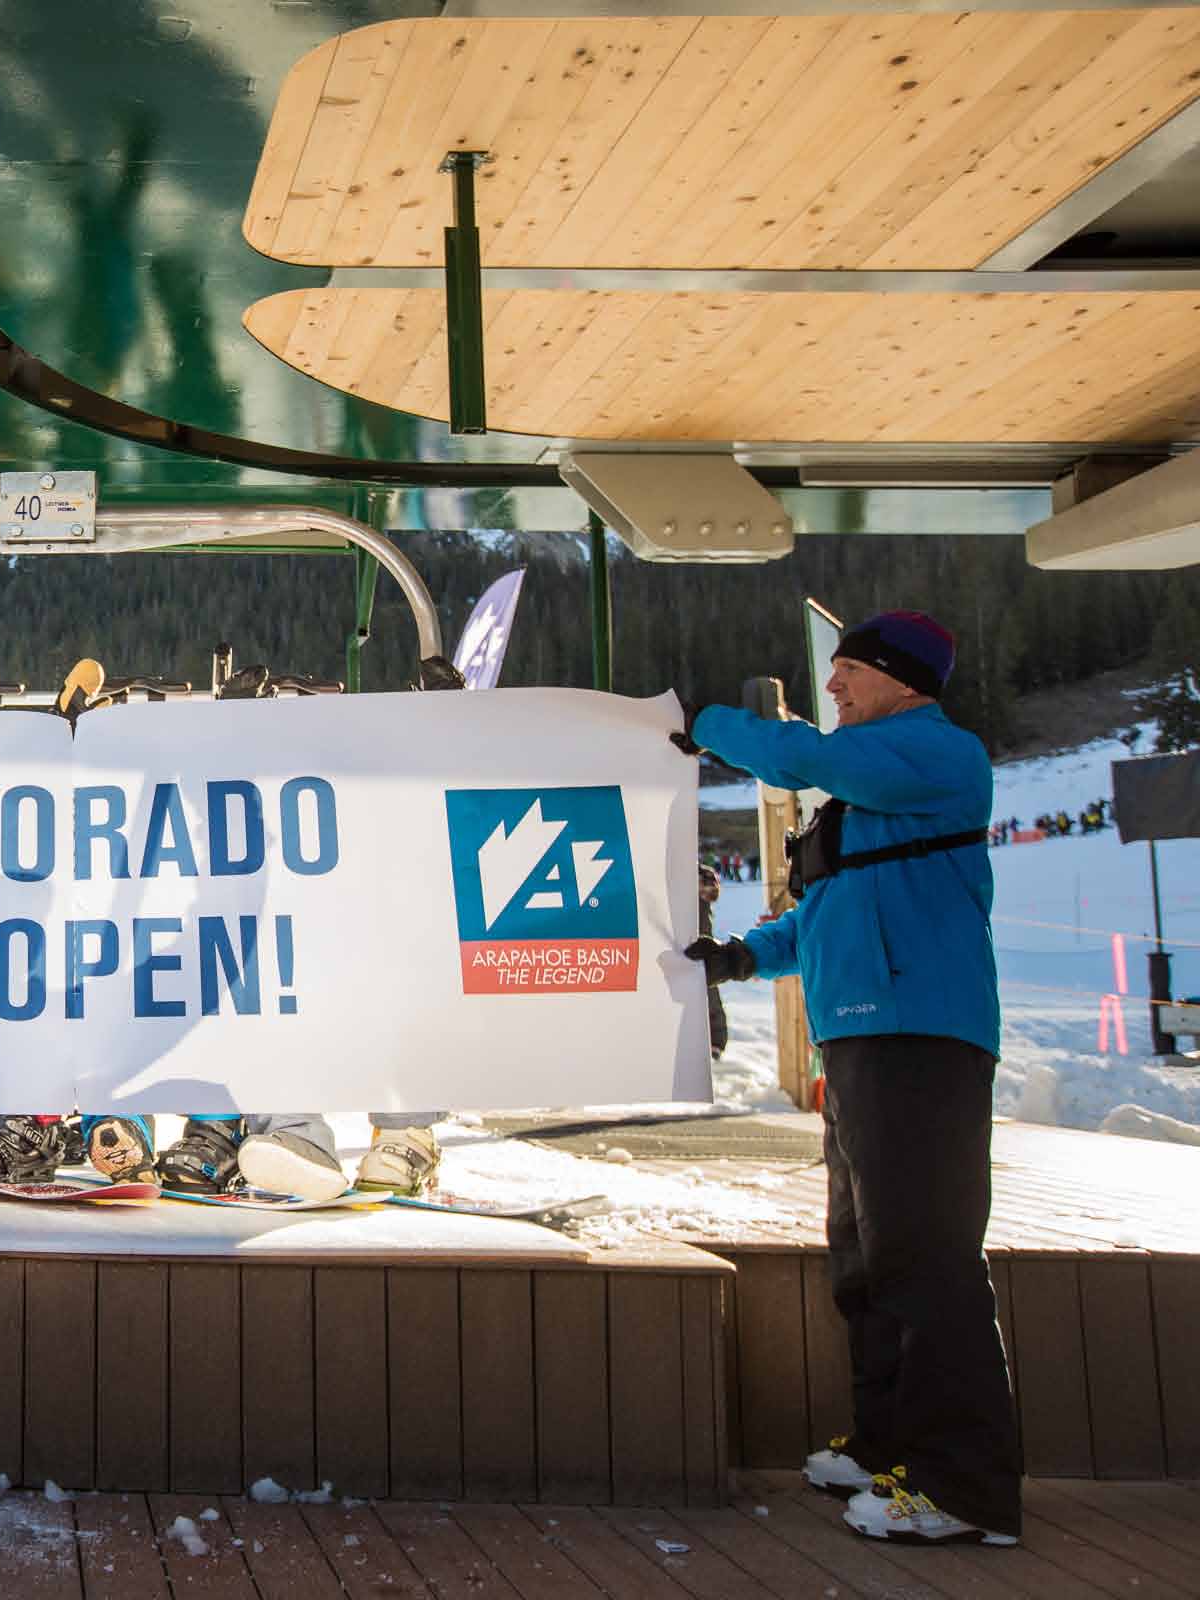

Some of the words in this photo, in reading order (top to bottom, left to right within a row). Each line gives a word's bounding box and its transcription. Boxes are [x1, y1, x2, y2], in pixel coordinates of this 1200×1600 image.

[14, 495, 42, 521] 40
[472, 948, 572, 967] ARAPAHOE
[577, 948, 631, 966] BASIN
[496, 968, 529, 985] THE
[534, 967, 606, 985] LEGEND
